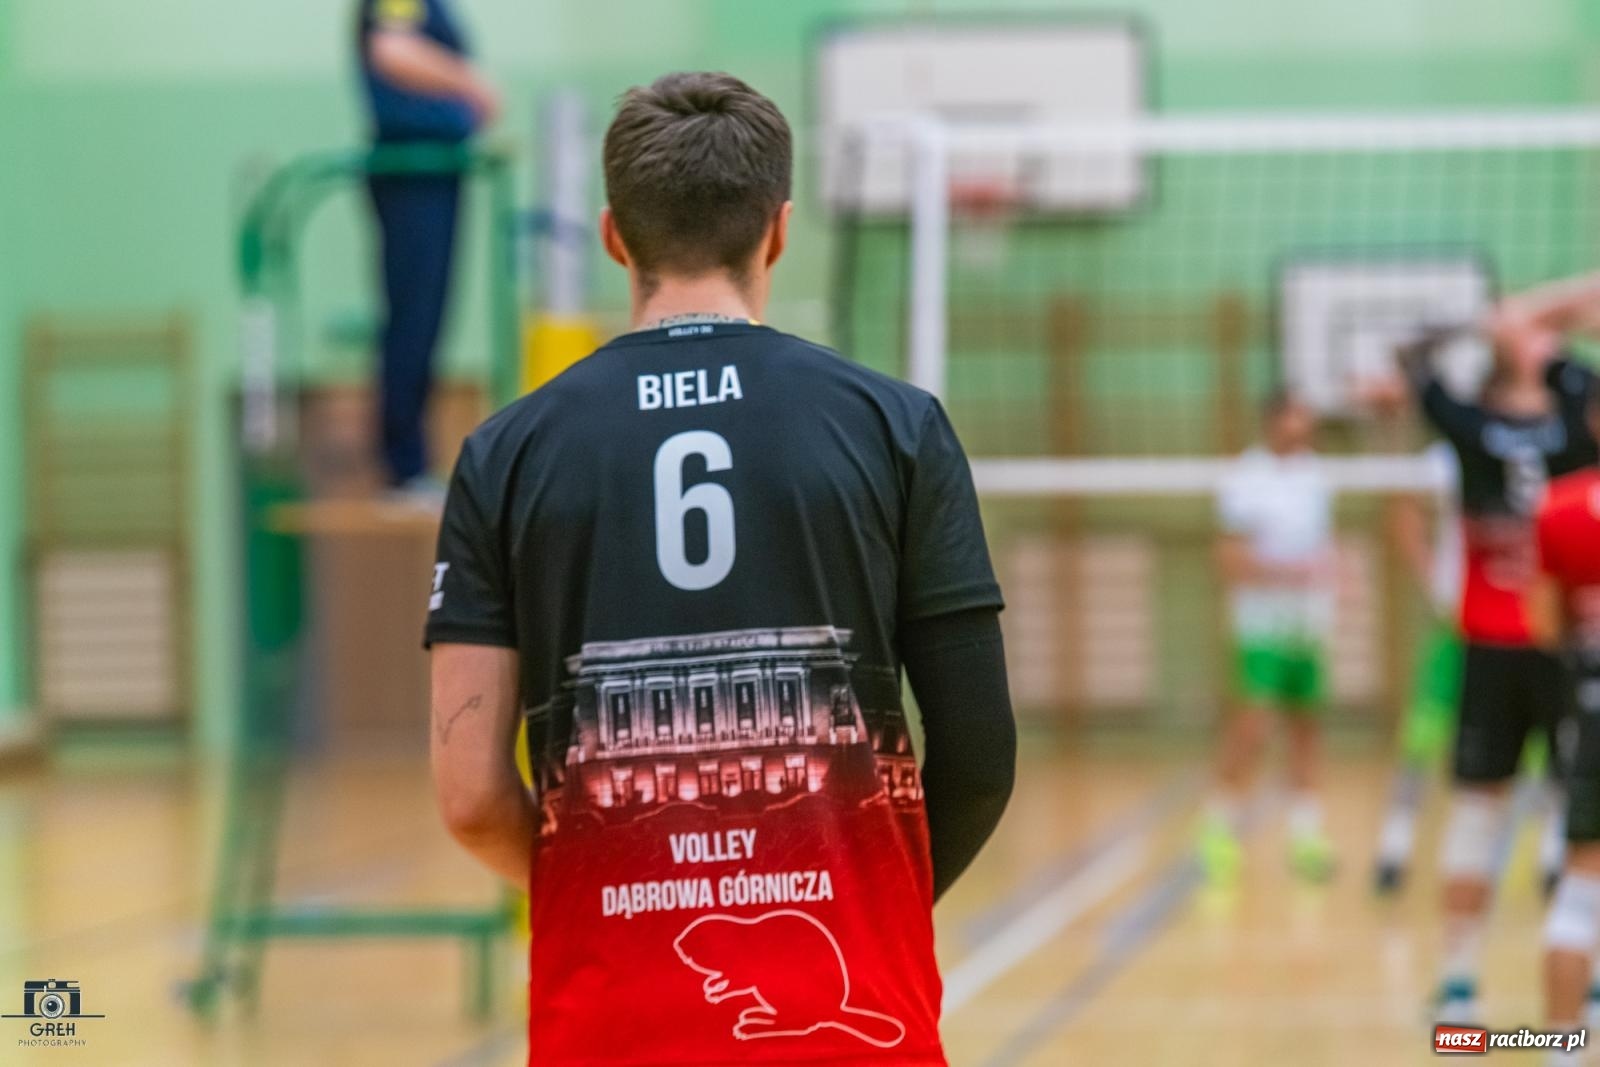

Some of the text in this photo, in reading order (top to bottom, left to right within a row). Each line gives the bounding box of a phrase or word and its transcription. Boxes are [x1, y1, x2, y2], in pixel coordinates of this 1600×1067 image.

[637, 364, 743, 410] BIELA
[653, 429, 736, 591] 6
[669, 828, 757, 864] VOLLEY
[602, 869, 834, 919] DĄBROWA GÓRNICZA
